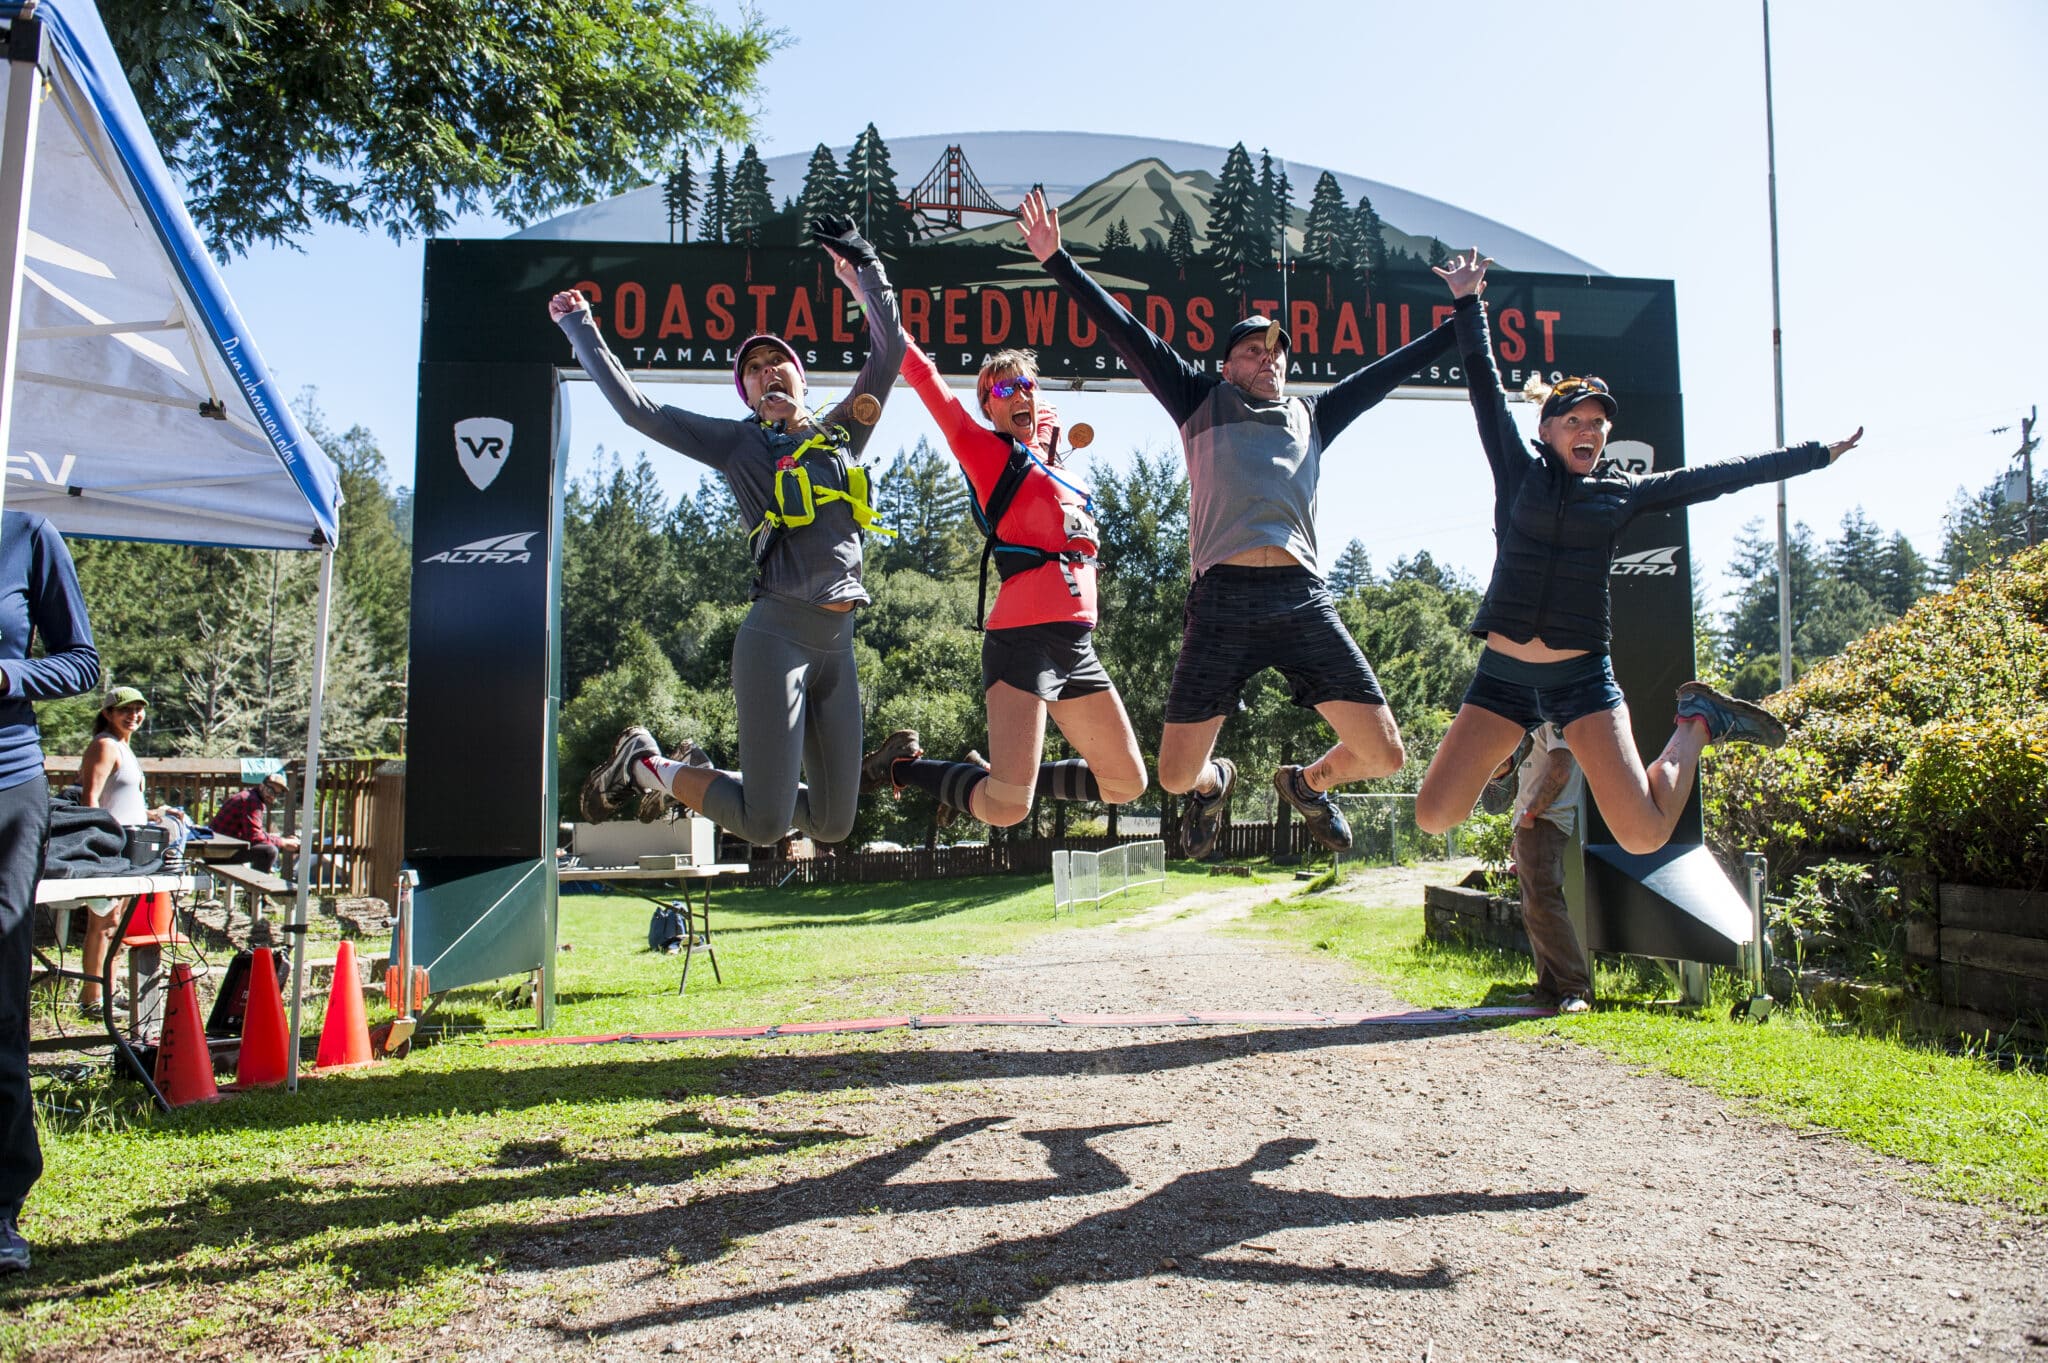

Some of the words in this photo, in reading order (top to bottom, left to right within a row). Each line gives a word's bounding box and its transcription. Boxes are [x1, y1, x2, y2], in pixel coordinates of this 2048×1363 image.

[902, 288, 1215, 352] REDWODS
[634, 347, 817, 363] TAMALS
[1095, 356, 1224, 373] SKNE
[460, 437, 503, 458] VR
[421, 552, 530, 563] ALTRA
[1610, 564, 1677, 575] LTRA
